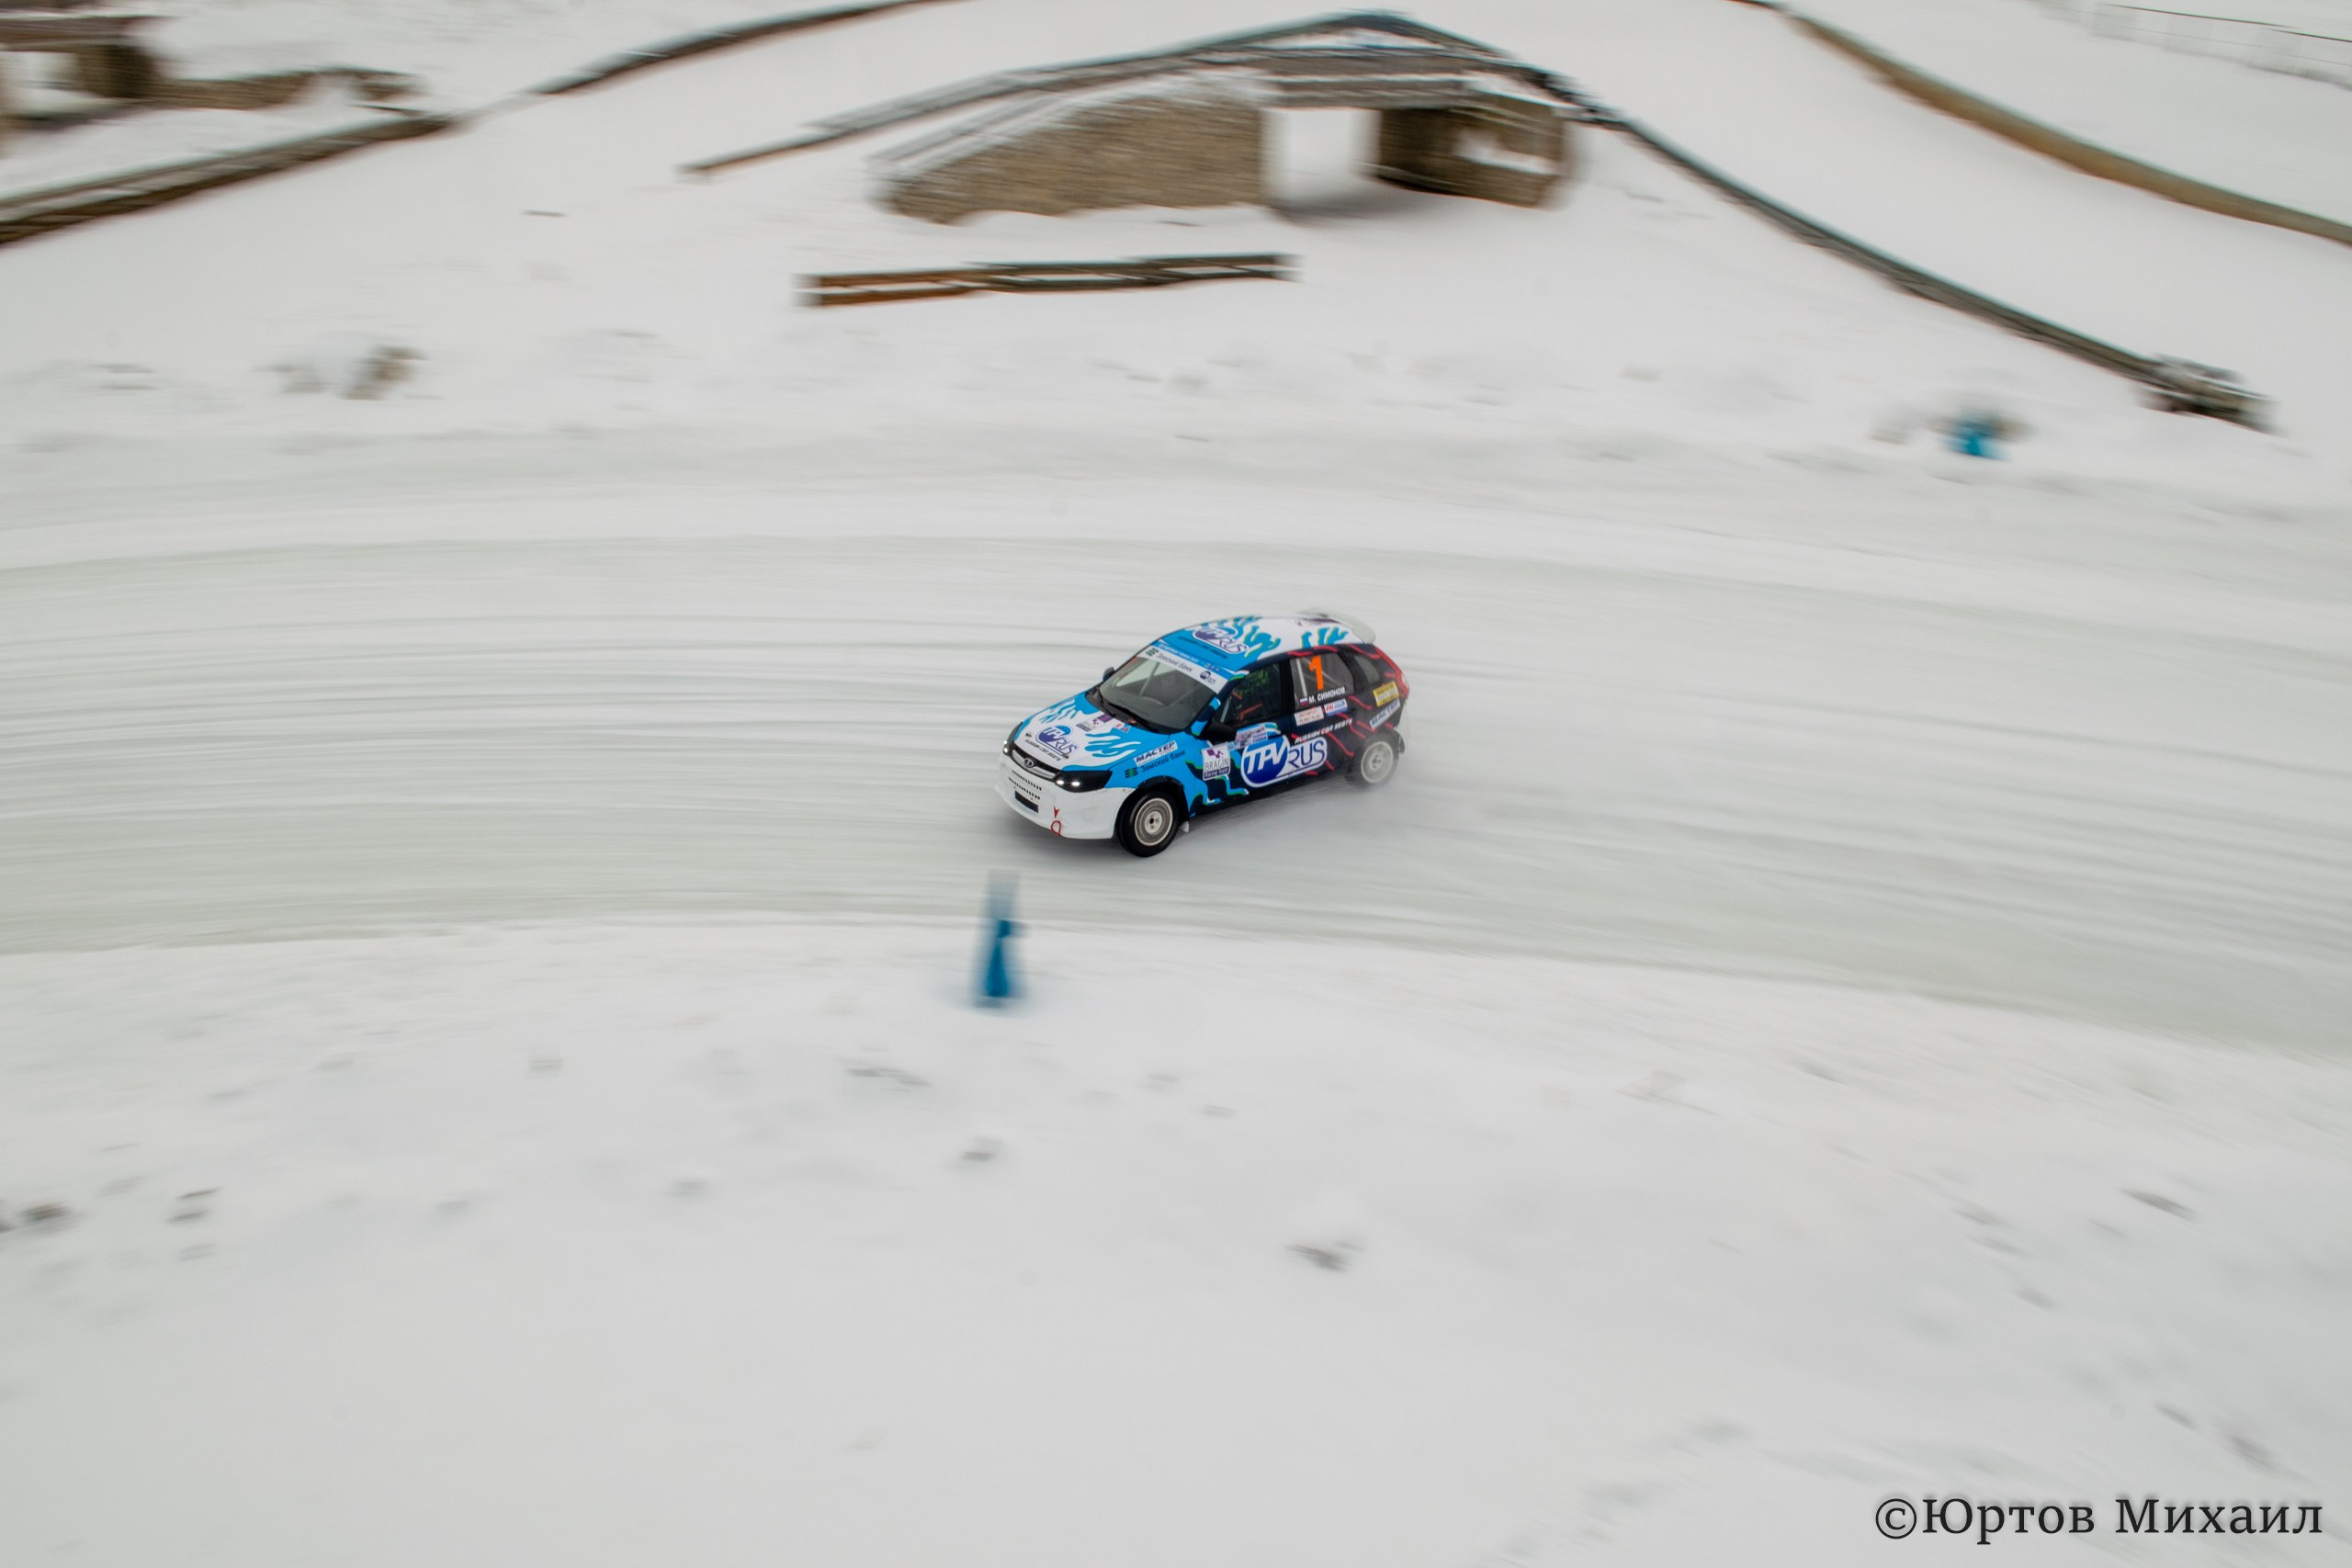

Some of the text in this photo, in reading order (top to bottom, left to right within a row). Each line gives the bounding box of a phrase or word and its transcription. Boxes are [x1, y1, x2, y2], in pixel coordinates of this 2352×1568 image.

[1308, 655, 1324, 691] 1
[1317, 686, 1346, 702] СИМОНОВ
[1136, 740, 1176, 763] МАСТЕР
[1141, 755, 1170, 773] Земский
[1170, 750, 1186, 761] банк
